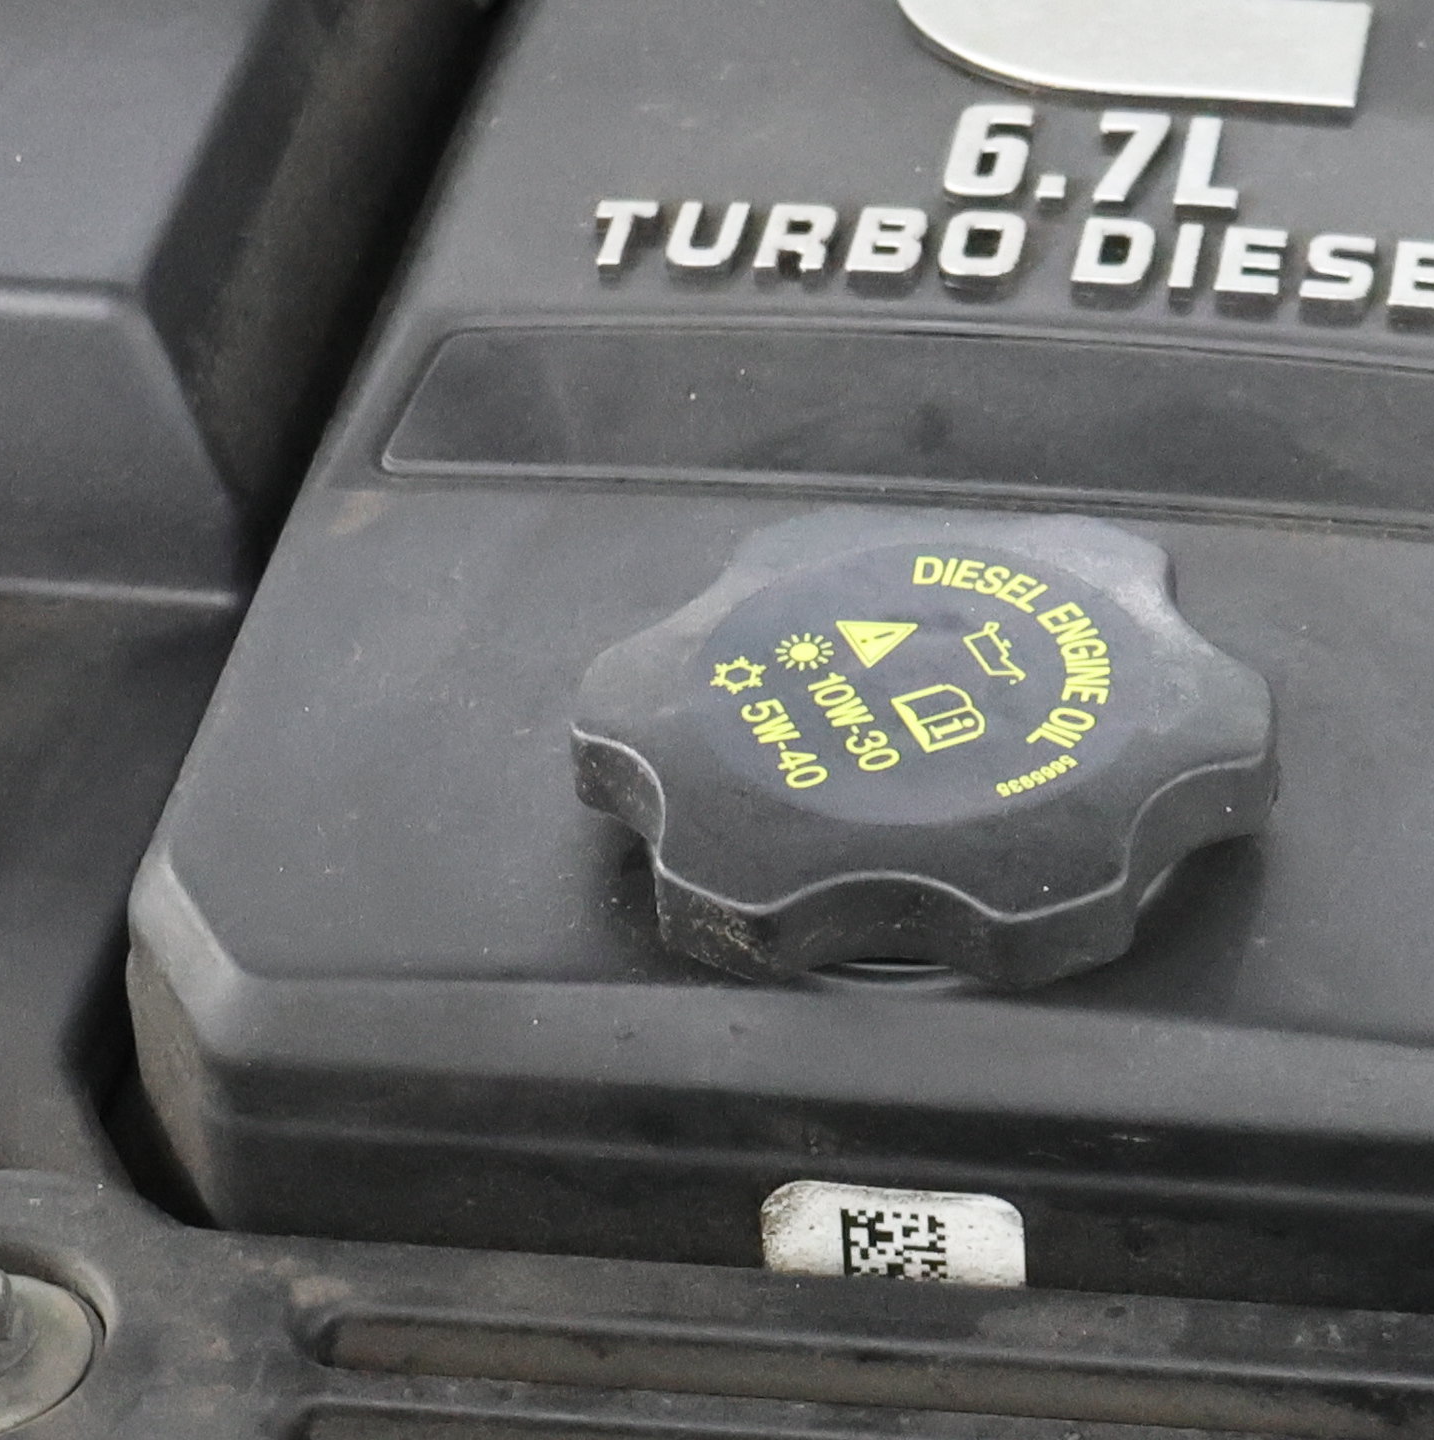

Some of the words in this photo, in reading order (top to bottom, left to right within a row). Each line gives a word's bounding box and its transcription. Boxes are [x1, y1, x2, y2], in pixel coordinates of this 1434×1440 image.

[942, 103, 1238, 211] 6.7L
[596, 200, 1025, 287] TURBO
[913, 556, 1048, 613] DIESEL
[1036, 601, 1111, 704] ENGINE
[741, 699, 828, 789] 5W-40
[808, 672, 900, 771] 10W-30
[1026, 707, 1096, 749] OIL
